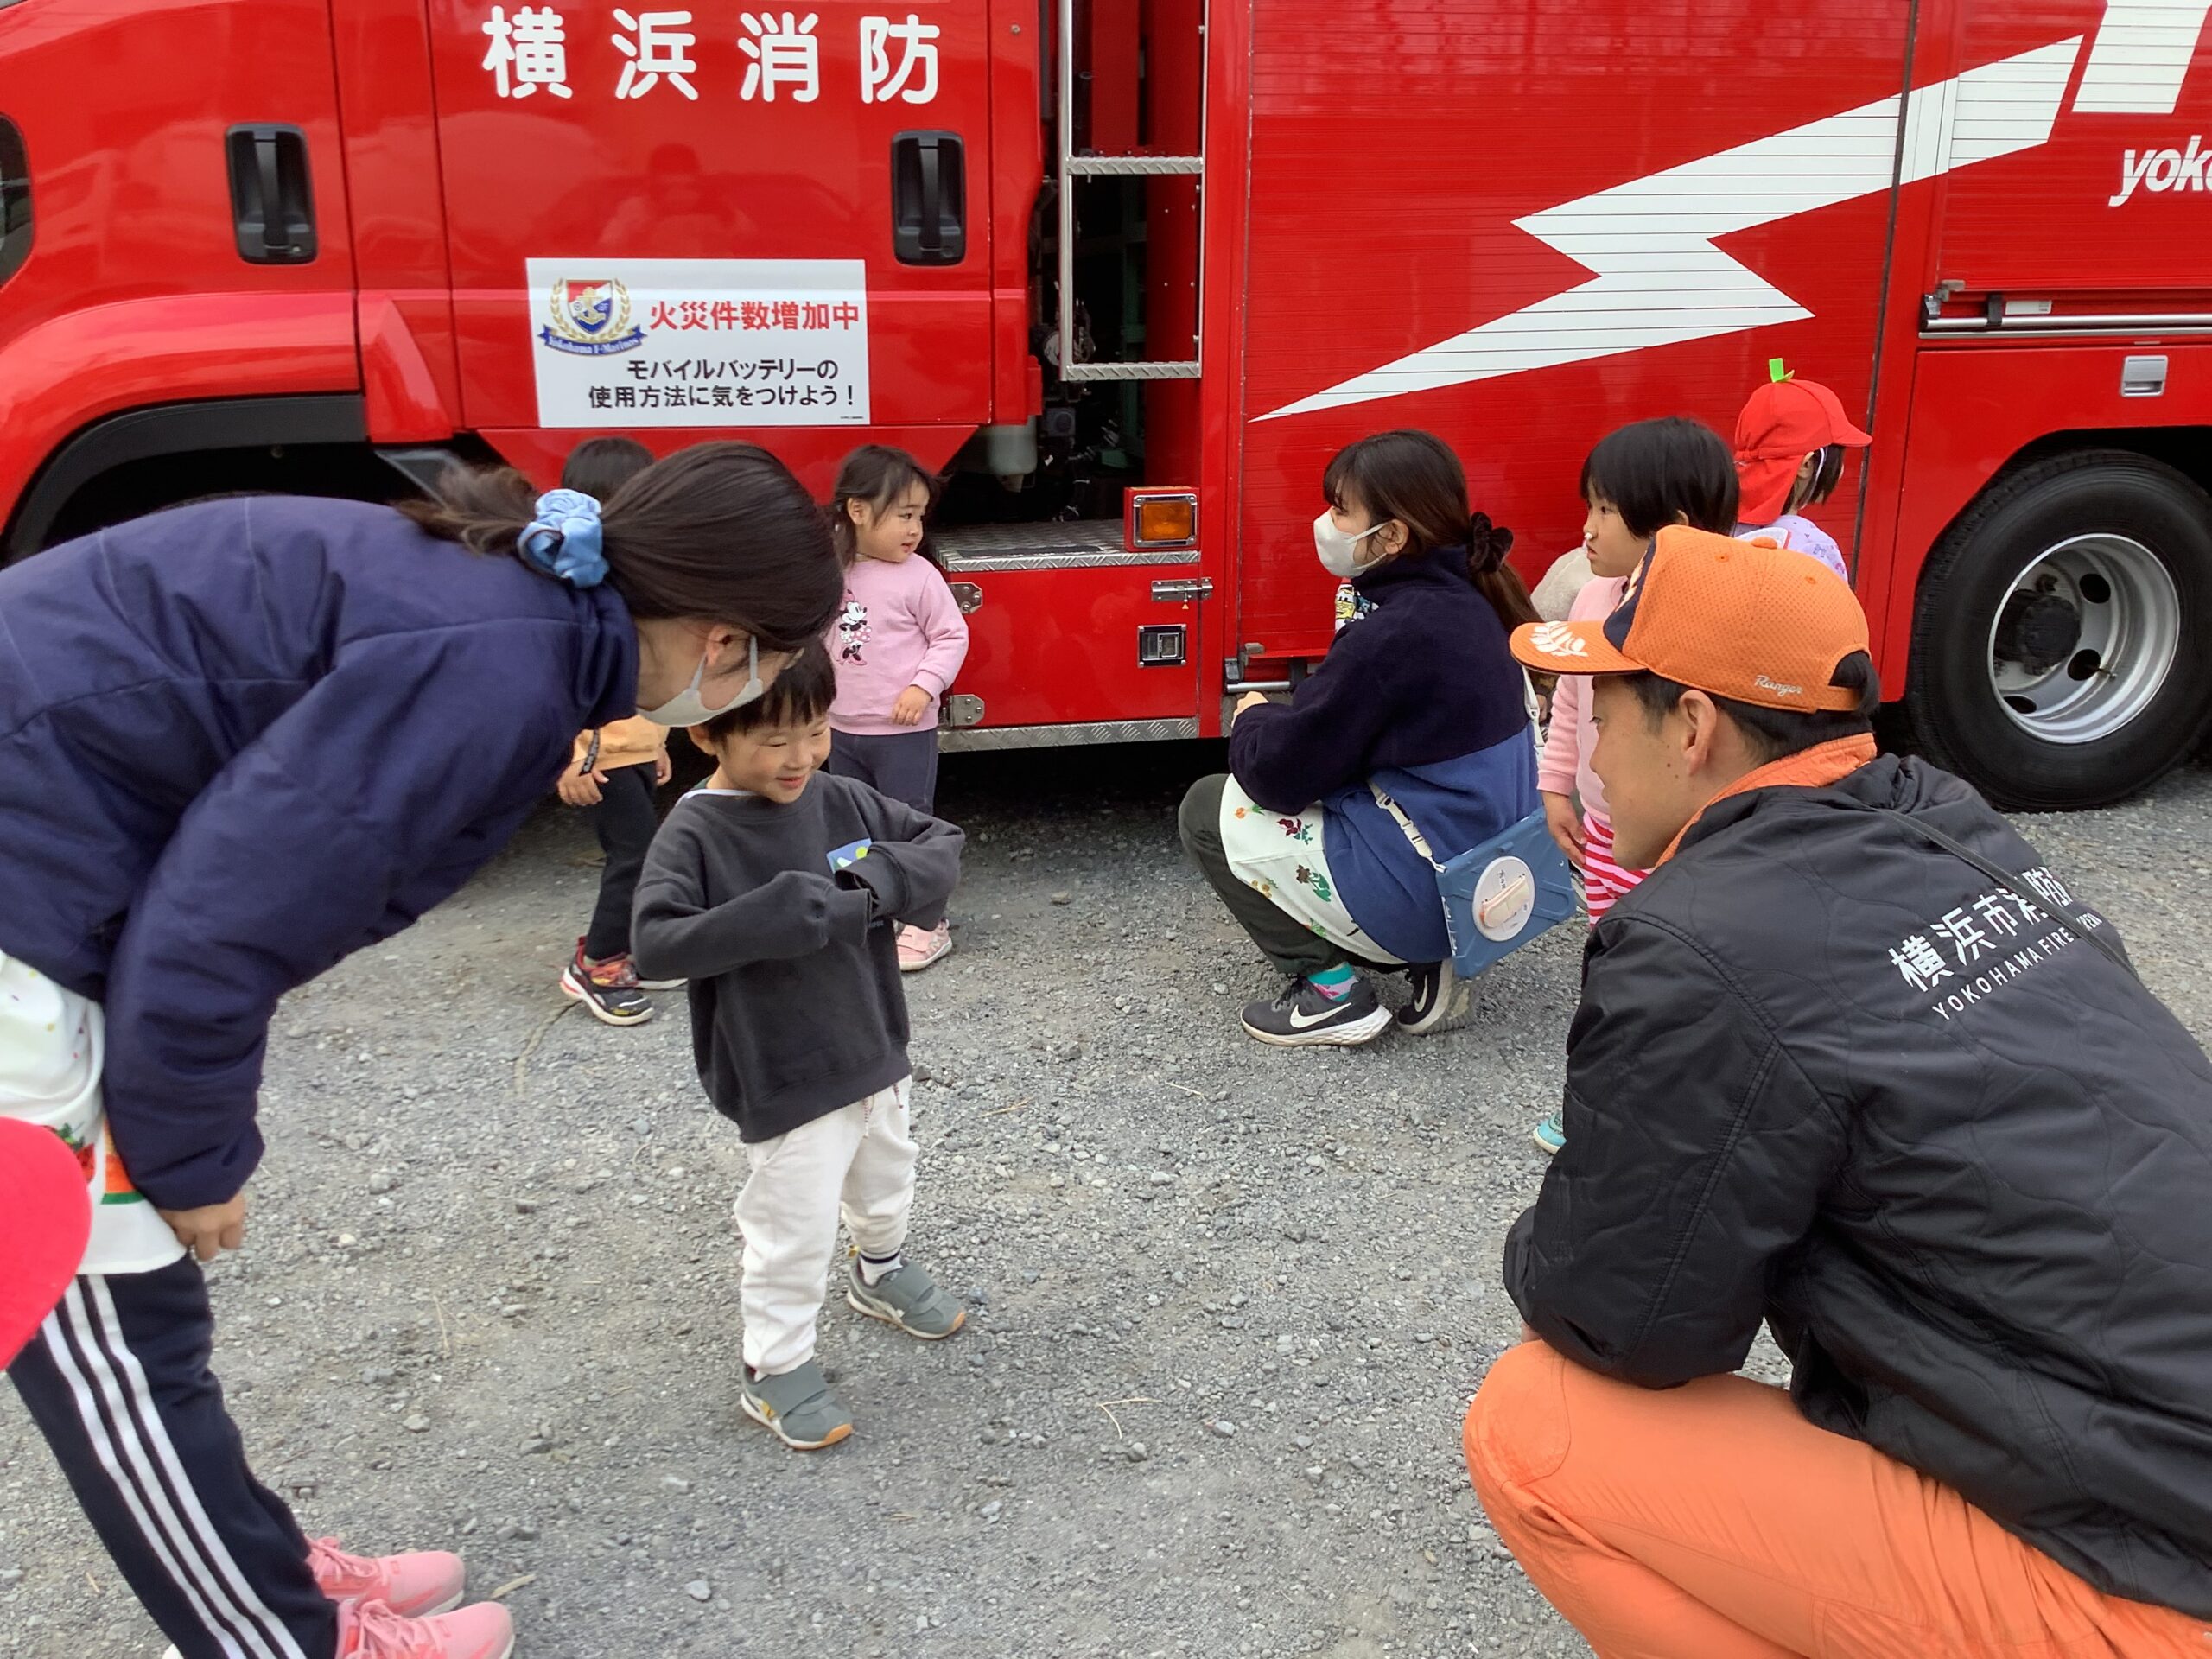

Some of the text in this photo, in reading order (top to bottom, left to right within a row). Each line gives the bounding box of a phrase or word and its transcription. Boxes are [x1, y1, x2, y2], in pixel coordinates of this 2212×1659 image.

[482, 5, 941, 104] 横浜消防
[2108, 135, 2212, 207] yok
[649, 301, 860, 331] 火災件数増加中
[626, 359, 839, 381] モバイルバッテリーの
[588, 385, 855, 408] 使用方法に気をつけよう！
[1754, 675, 1802, 696] Ranger
[1932, 947, 2044, 1020] YOKOHAMA
[2037, 927, 2075, 956] FIRE
